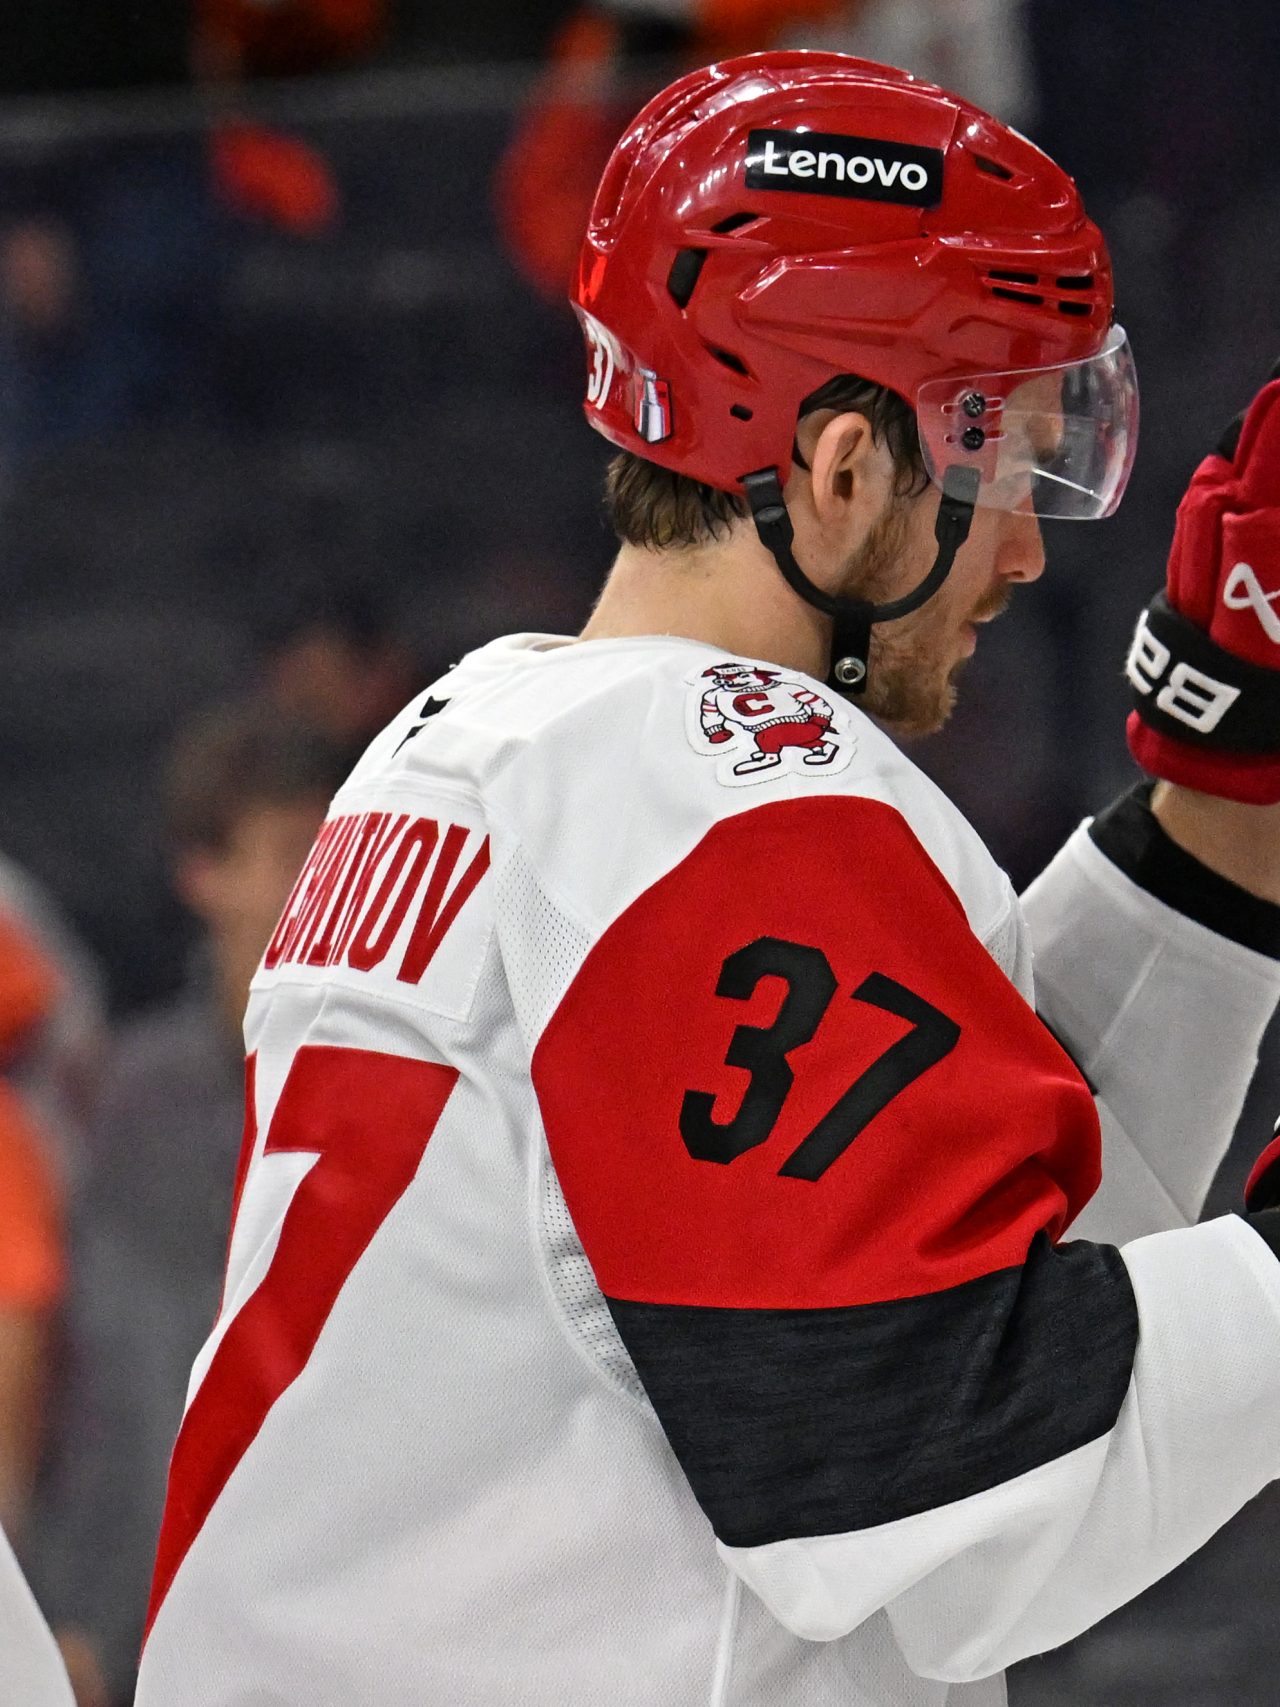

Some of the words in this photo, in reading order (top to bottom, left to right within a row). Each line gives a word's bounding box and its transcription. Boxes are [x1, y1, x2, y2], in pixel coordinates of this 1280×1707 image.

[764, 140, 928, 191] Lenovo
[585, 318, 614, 410] 37
[733, 692, 775, 717] C
[678, 936, 961, 1182] 37
[138, 1043, 460, 1670] 7
